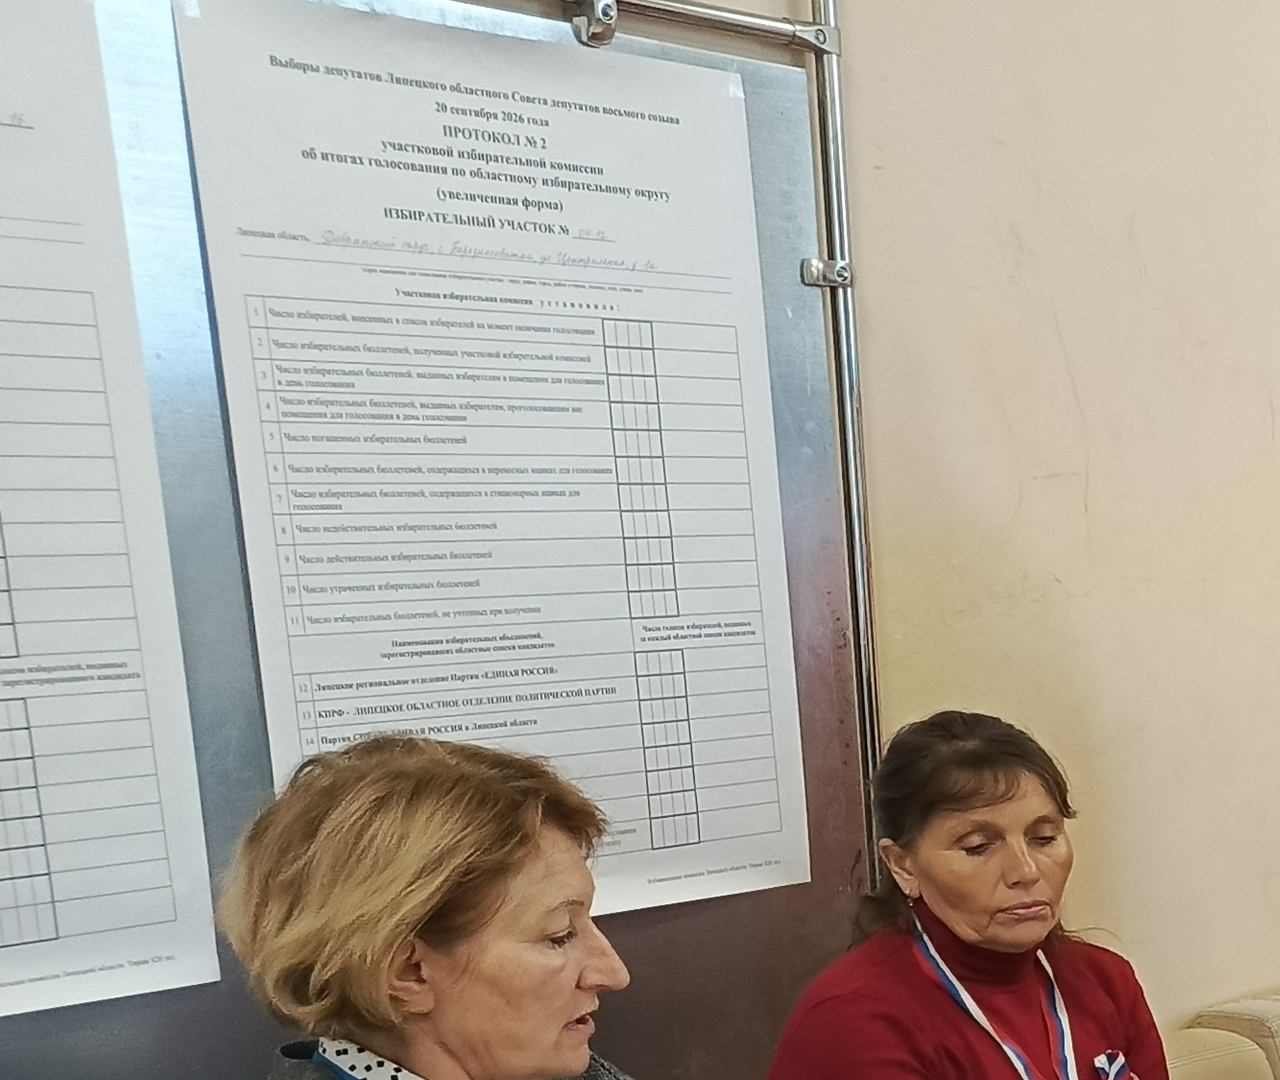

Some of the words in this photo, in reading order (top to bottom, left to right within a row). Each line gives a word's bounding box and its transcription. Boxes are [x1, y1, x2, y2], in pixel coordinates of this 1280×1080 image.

[268, 54, 320, 74] Выборы
[323, 65, 382, 82] депутатов
[384, 71, 447, 91] Липецкого
[448, 82, 509, 100] областного
[510, 90, 548, 106] Совета
[550, 99, 600, 113] депутатов
[602, 106, 646, 120] восьмого
[647, 113, 680, 125] созыва
[434, 101, 447, 113] 20
[449, 106, 498, 122] сентября
[500, 110, 524, 123] 2026
[526, 116, 549, 127] года
[442, 124, 520, 146] ПРОТОКОЛ
[523, 135, 537, 148] №
[539, 137, 546, 149] 2
[380, 140, 453, 157] участковой
[456, 148, 546, 168] избирательной
[549, 160, 603, 175] комиссии
[301, 148, 317, 159] об
[320, 151, 364, 165] итогах
[367, 157, 447, 175] голосования
[450, 167, 466, 177] по
[468, 167, 538, 188] областному
[541, 176, 630, 198] избирательному
[634, 188, 669, 203] округу
[436, 187, 518, 206] (увеличенная
[521, 195, 563, 212] форма)
[383, 207, 495, 228] ИЗБИРАТЕЛЬНЫЙ
[498, 218, 555, 234] УЧАСТОК
[557, 224, 569, 235] №
[317, 708, 344, 718] КПРФ
[352, 703, 405, 715] ЛИПЕЦКОЕ
[405, 699, 460, 711] ОБЛАСТНОЕ
[461, 694, 513, 706] ОТДЕЛЕНИЕ
[514, 687, 583, 702] ПОЛИТИЧЕСКОЙ
[584, 686, 616, 696] ПАРТИИ
